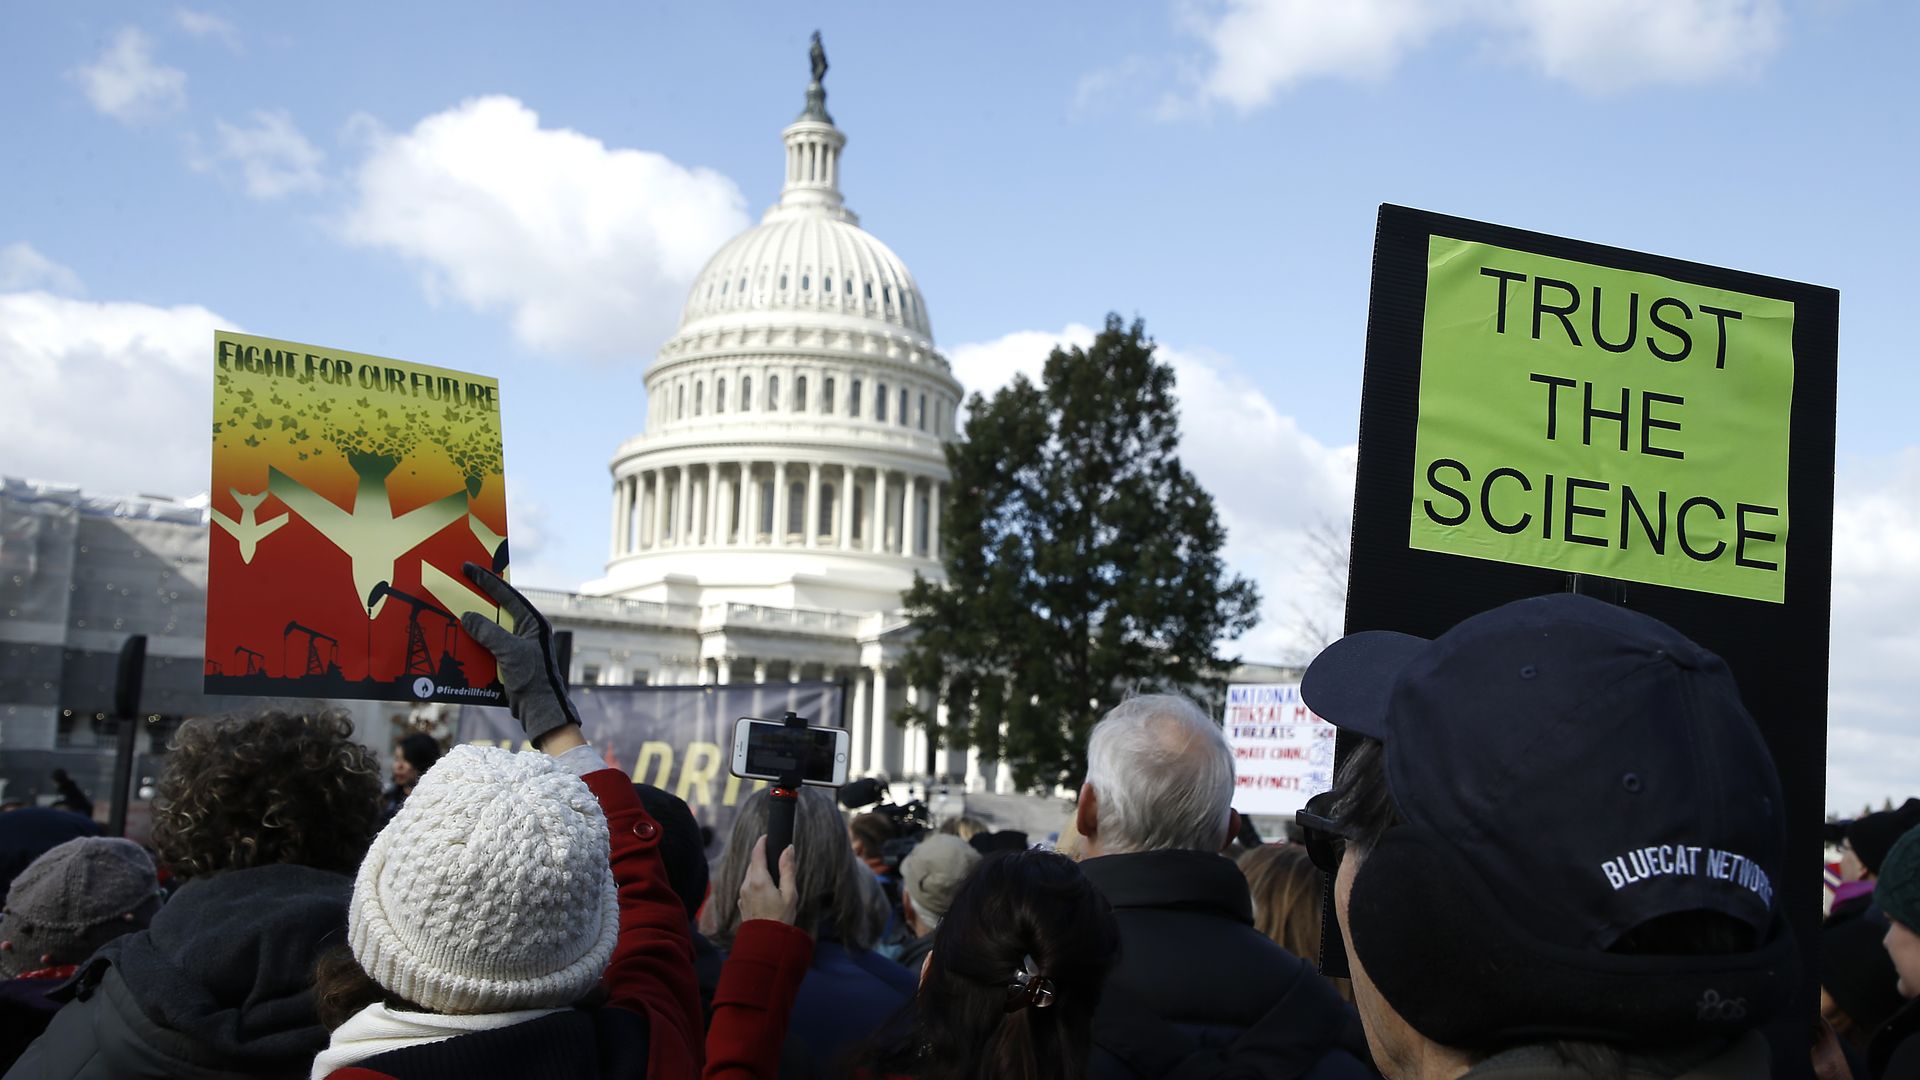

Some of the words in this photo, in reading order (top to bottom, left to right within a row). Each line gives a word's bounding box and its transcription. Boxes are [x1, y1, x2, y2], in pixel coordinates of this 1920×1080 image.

[1480, 267, 1742, 369] TRUST
[219, 341, 299, 378] FIGHT
[305, 354, 353, 387] FOR
[358, 365, 406, 395] OUR
[410, 372, 498, 412] FUTURE
[1530, 373, 1685, 459] THE
[1424, 459, 1779, 571] SCIENCE
[436, 686, 501, 700] @firedrillfriday
[1601, 845, 1702, 890] BLUECAT
